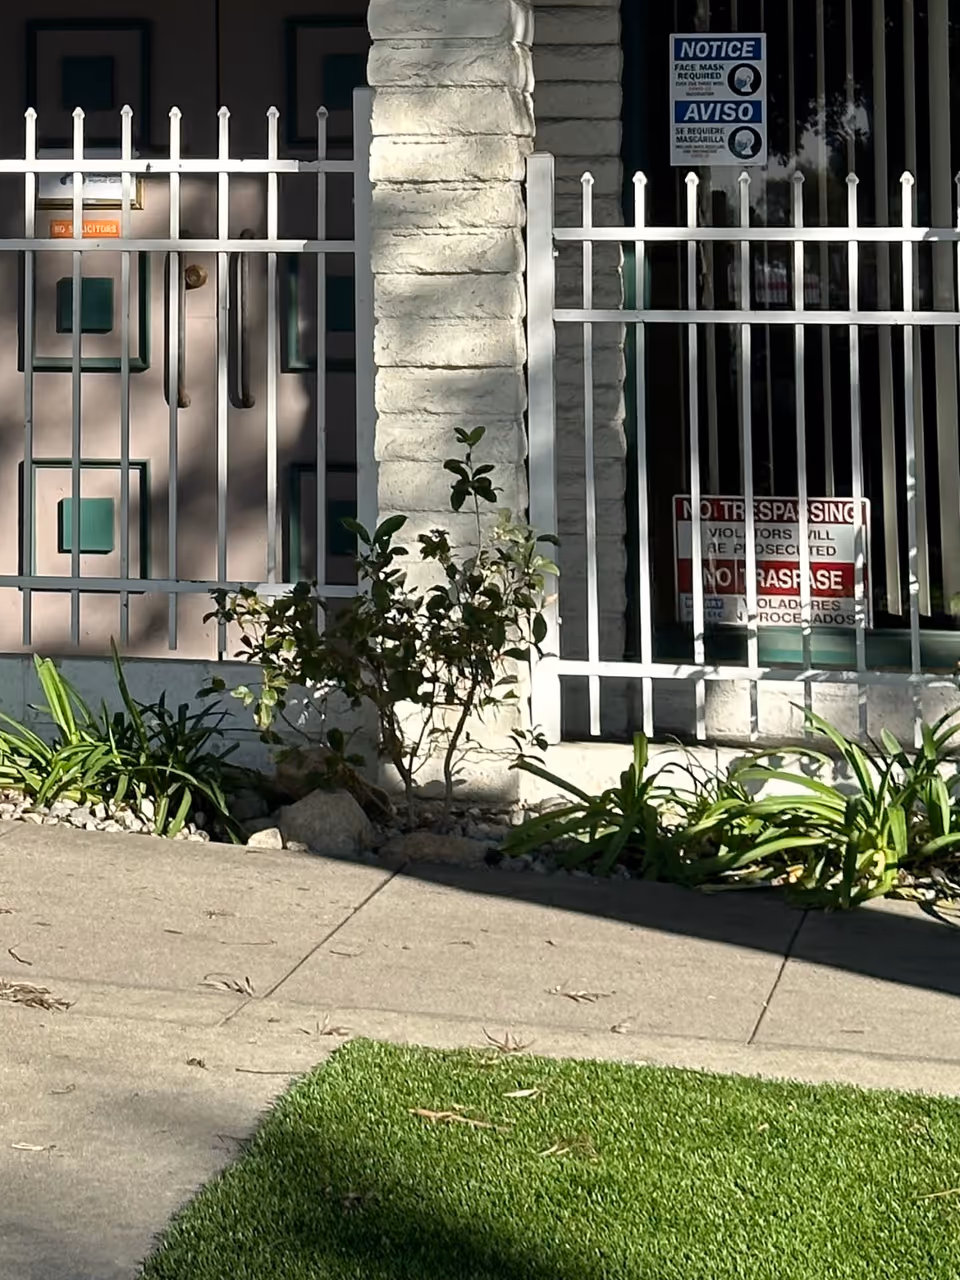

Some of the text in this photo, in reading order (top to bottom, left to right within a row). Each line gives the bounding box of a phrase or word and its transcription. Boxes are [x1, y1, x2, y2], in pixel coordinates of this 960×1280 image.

[680, 41, 756, 58] NOTICE
[674, 63, 725, 71] FACE MASK
[677, 72, 722, 80] REQUIRED
[683, 103, 754, 121] AVISO
[675, 127, 725, 135] SE REQUIERE
[675, 135, 725, 143] MASCARILLA
[683, 500, 712, 520] NO
[703, 567, 732, 587] NO
